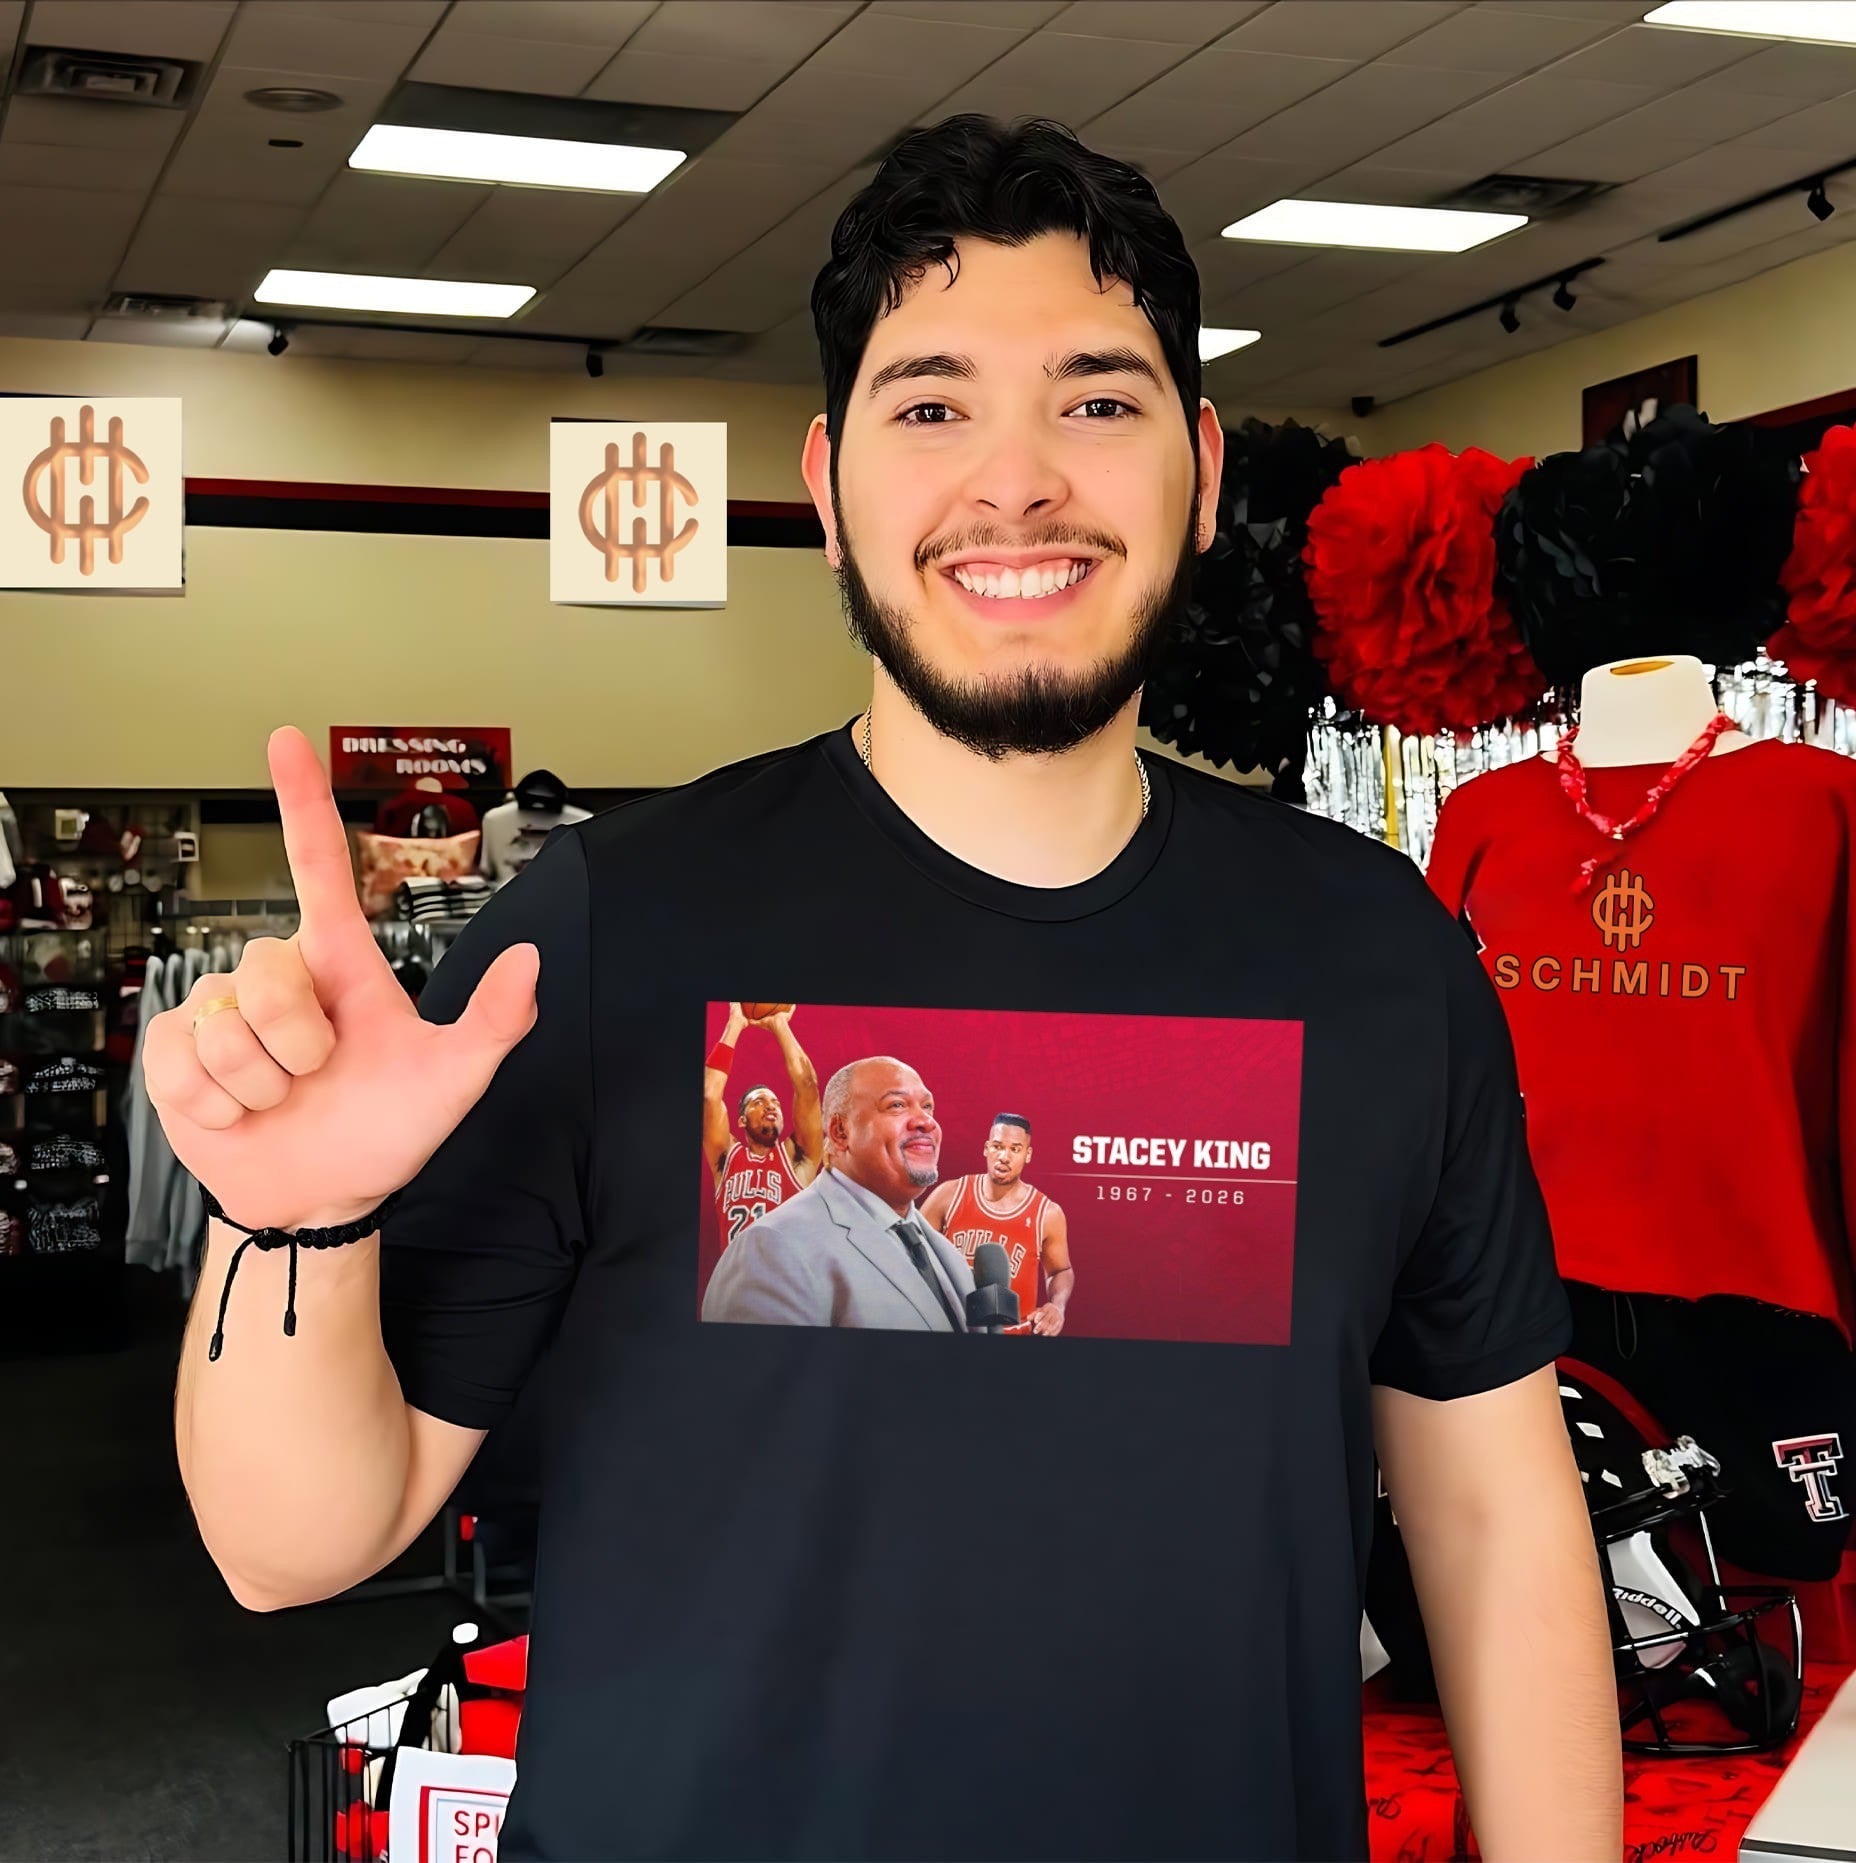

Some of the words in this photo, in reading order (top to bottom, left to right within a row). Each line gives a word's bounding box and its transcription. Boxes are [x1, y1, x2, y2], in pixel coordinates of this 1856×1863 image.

[396, 758, 487, 775] ROOMS
[1494, 953, 1747, 1001] SCHMIDT
[1072, 1135, 1187, 1167] STACEY
[1193, 1139, 1271, 1170] KING
[1097, 1185, 1151, 1201] 1967
[1185, 1188, 1245, 1205] 2026
